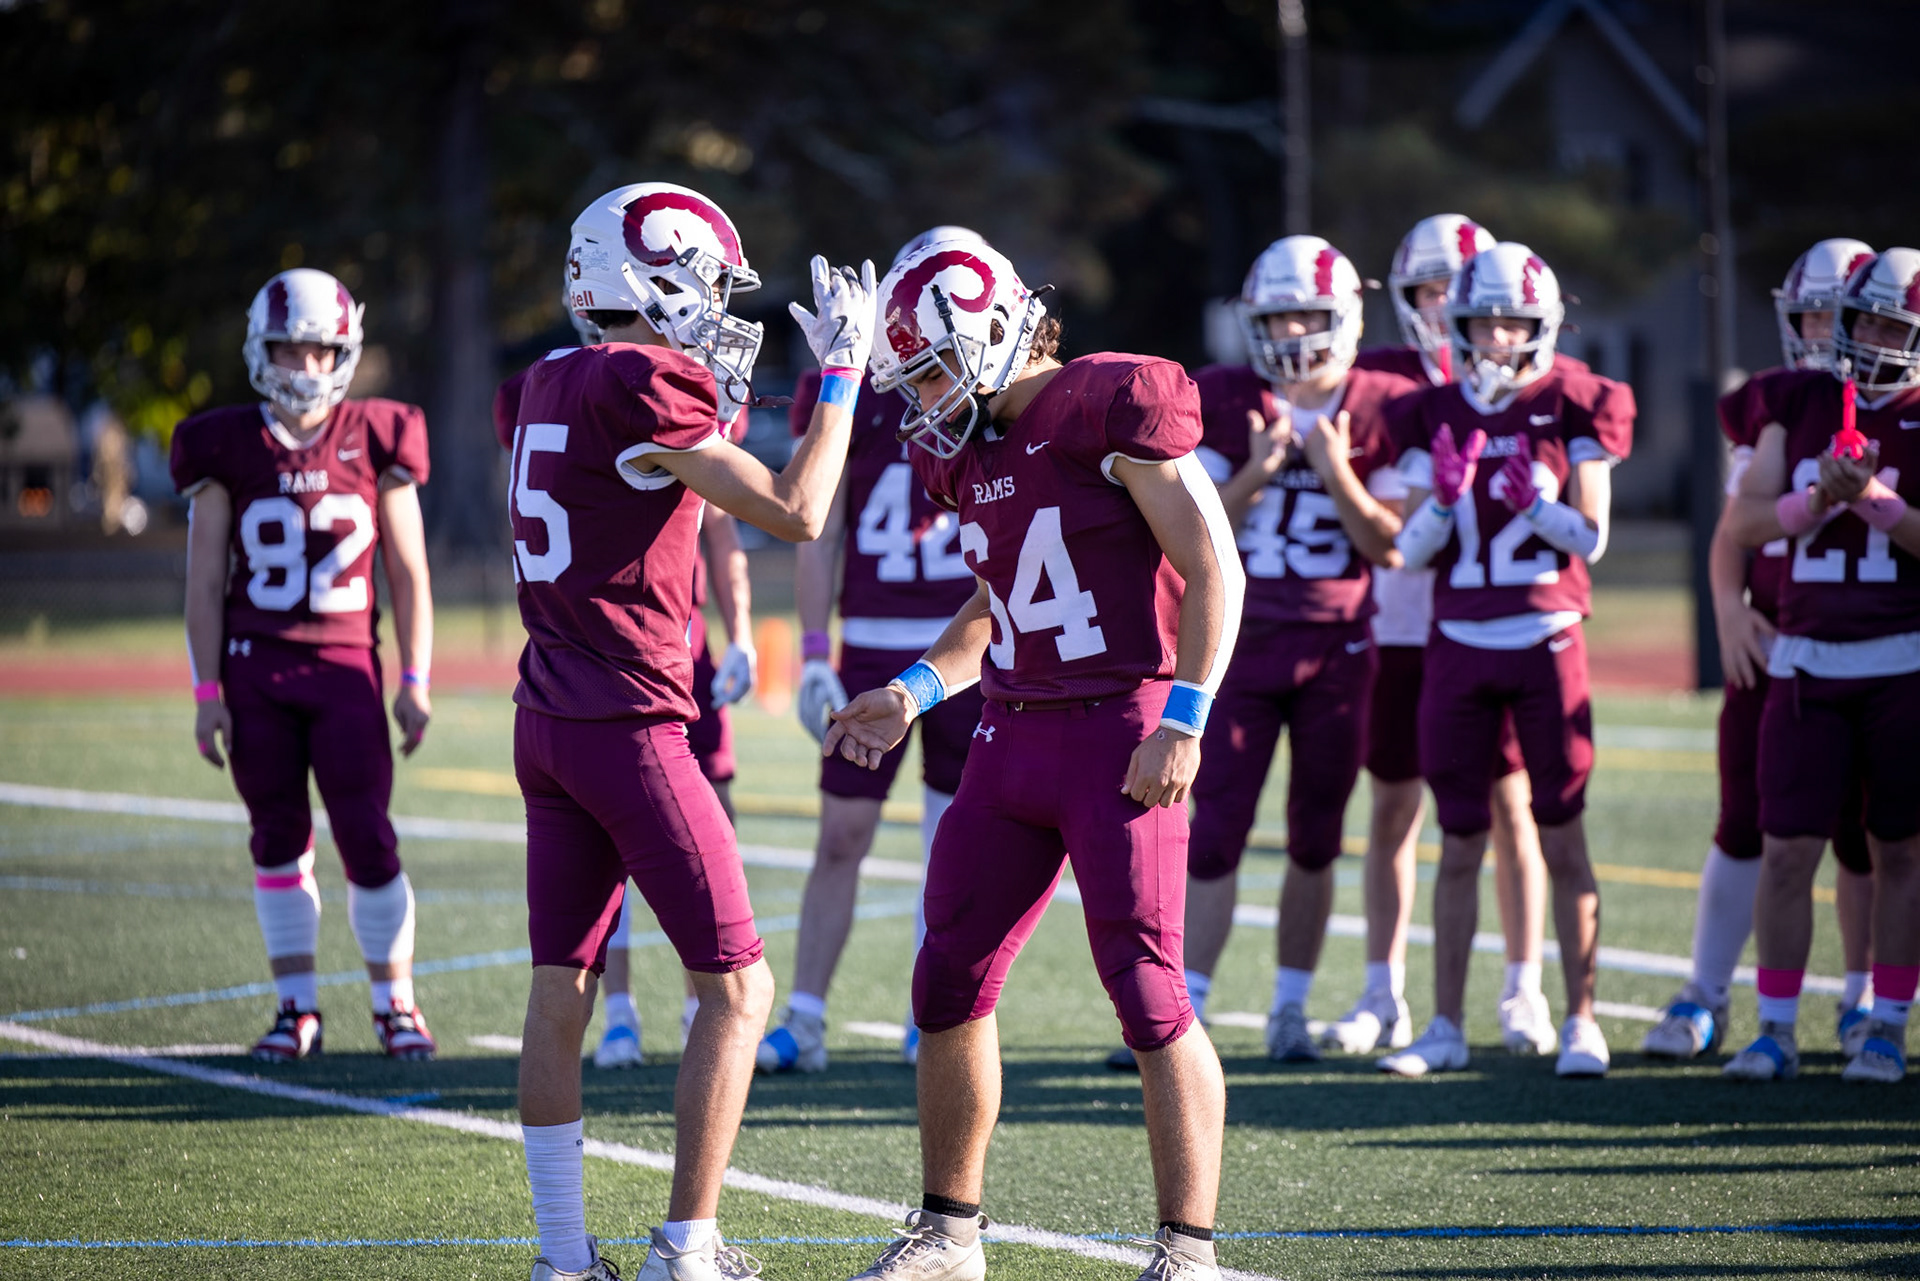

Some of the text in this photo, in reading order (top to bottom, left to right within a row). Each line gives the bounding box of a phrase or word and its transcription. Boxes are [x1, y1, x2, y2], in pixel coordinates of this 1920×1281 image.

[278, 470, 329, 494] RAMS
[972, 476, 1015, 504] RAMS
[1449, 461, 1560, 590] 12
[240, 494, 375, 613] 82
[1237, 486, 1352, 580] 45
